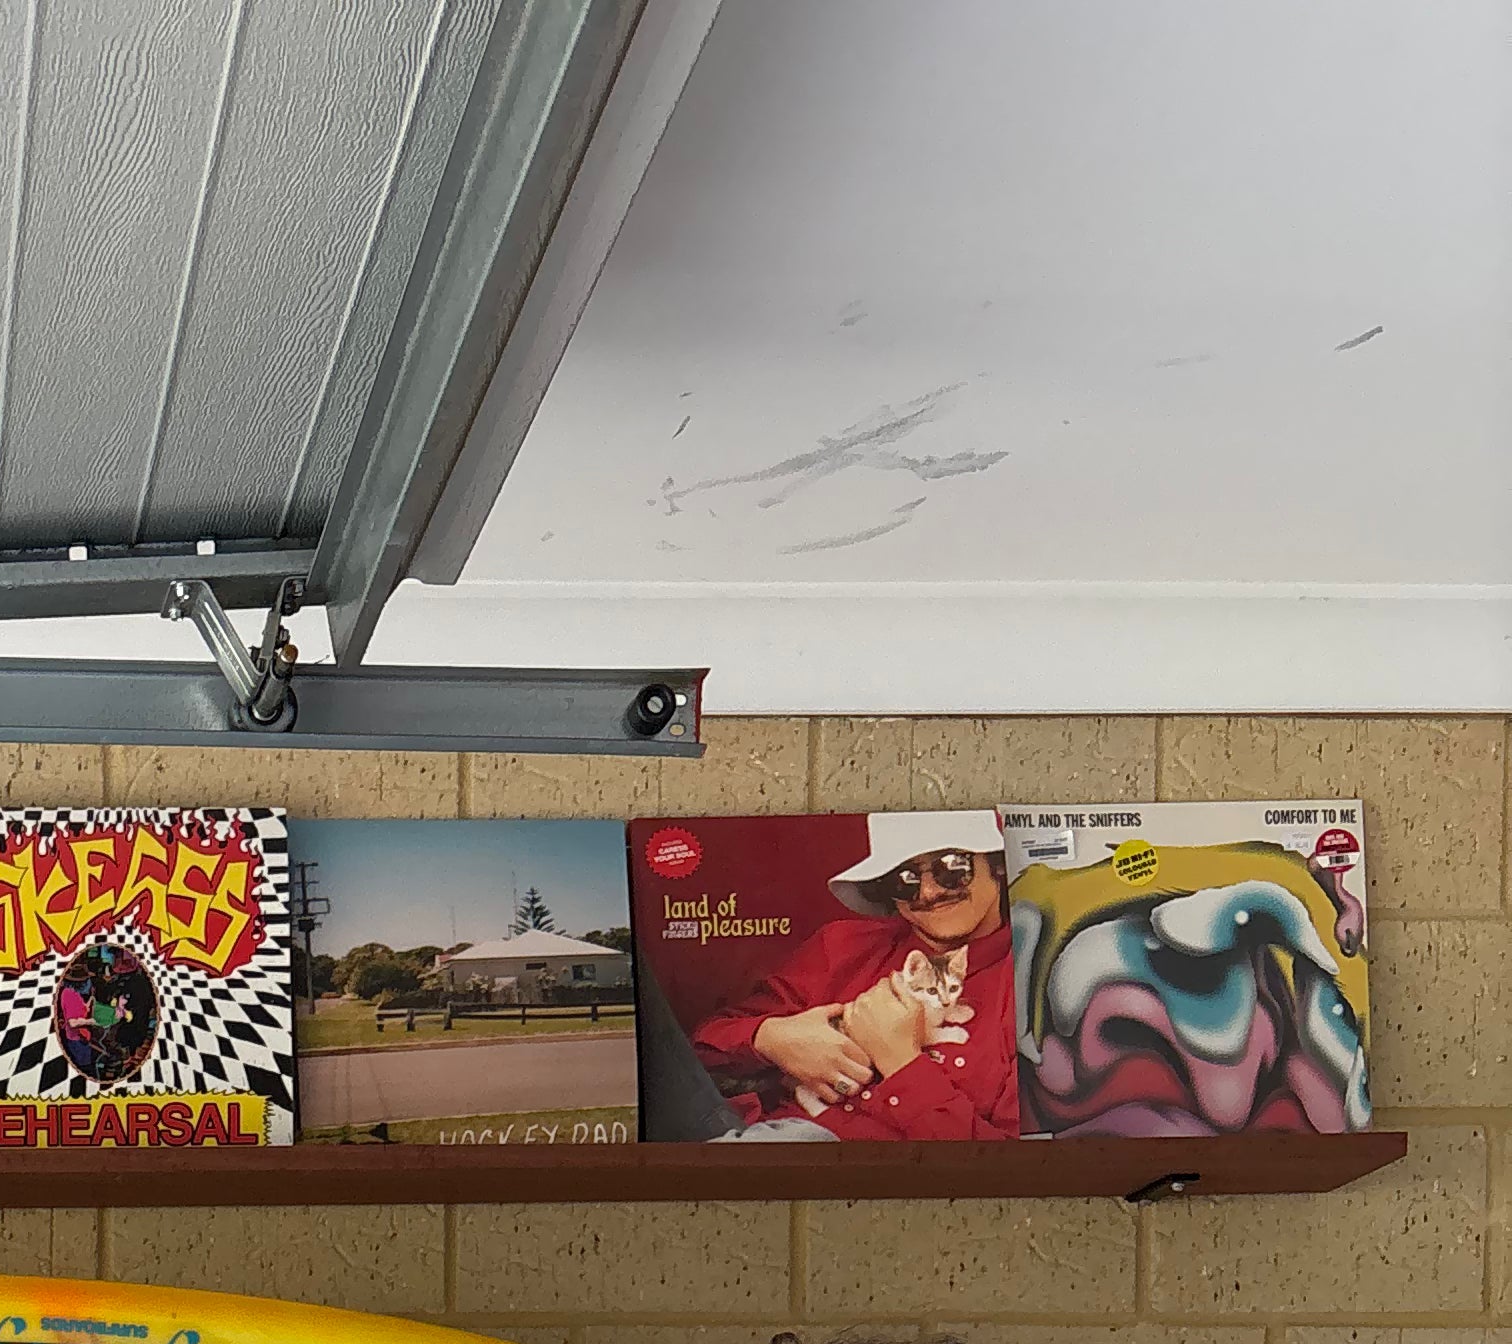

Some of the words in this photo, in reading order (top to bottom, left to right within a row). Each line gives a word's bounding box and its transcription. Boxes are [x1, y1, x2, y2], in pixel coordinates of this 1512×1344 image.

[1004, 813, 1035, 828] AMYL
[1038, 813, 1061, 828] AND
[1064, 813, 1087, 828] THE
[1089, 812, 1142, 828] SNIFFERS
[1264, 809, 1319, 825] COMFORT
[1321, 808, 1337, 824] TO
[1340, 808, 1358, 824] ME
[663, 893, 710, 919] land
[717, 893, 737, 917] of
[700, 912, 791, 945] pleasure
